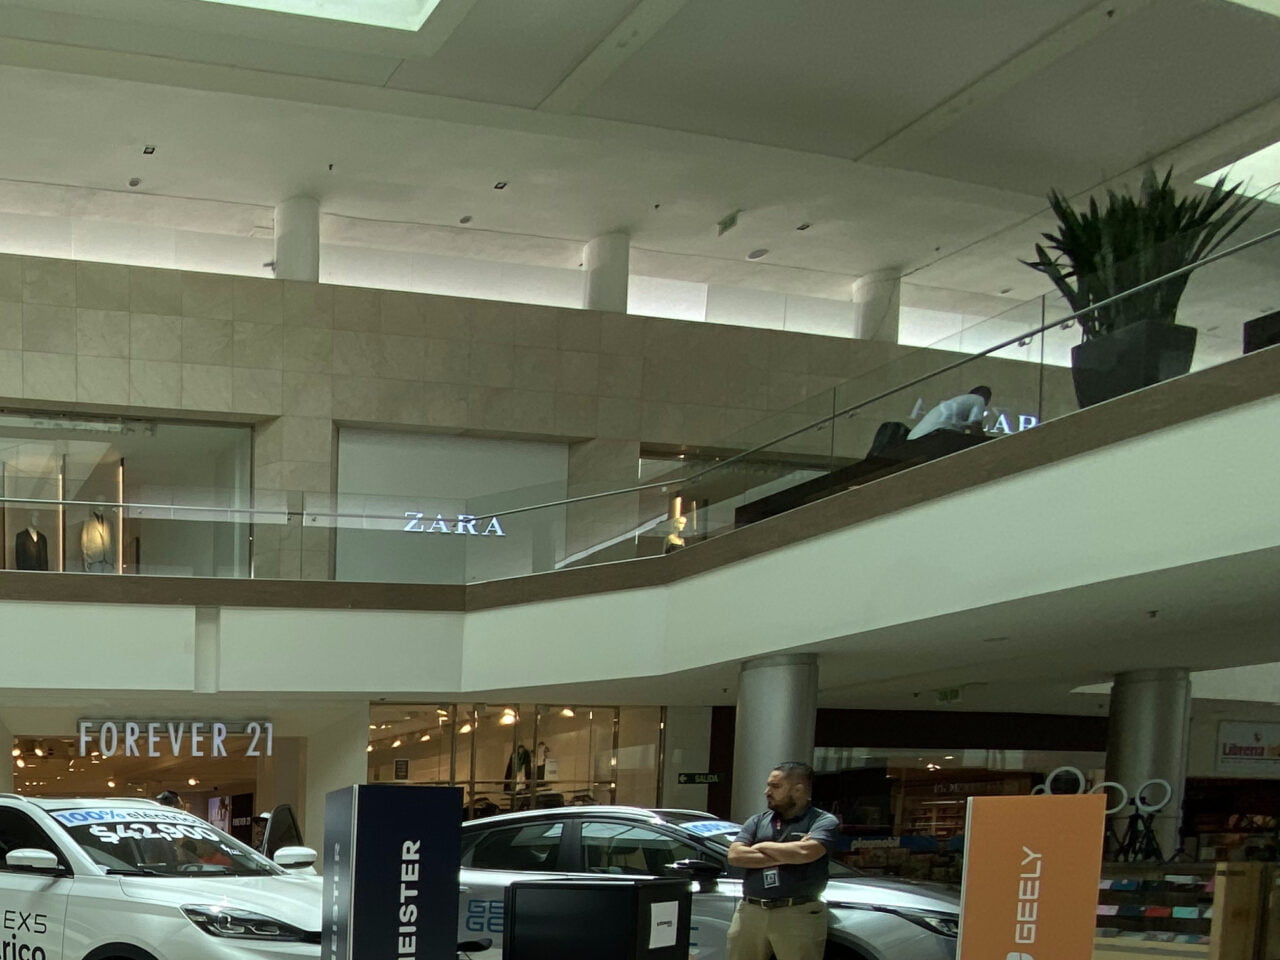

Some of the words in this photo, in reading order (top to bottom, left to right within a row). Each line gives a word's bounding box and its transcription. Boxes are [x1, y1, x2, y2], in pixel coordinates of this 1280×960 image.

[404, 511, 506, 536] ZARA
[79, 721, 228, 757] FOREVER
[245, 721, 273, 757] 21
[57, 808, 126, 823] 100%
[89, 823, 220, 844] $42,900
[1015, 846, 1042, 943] GEELY
[4, 910, 47, 934] EX5
